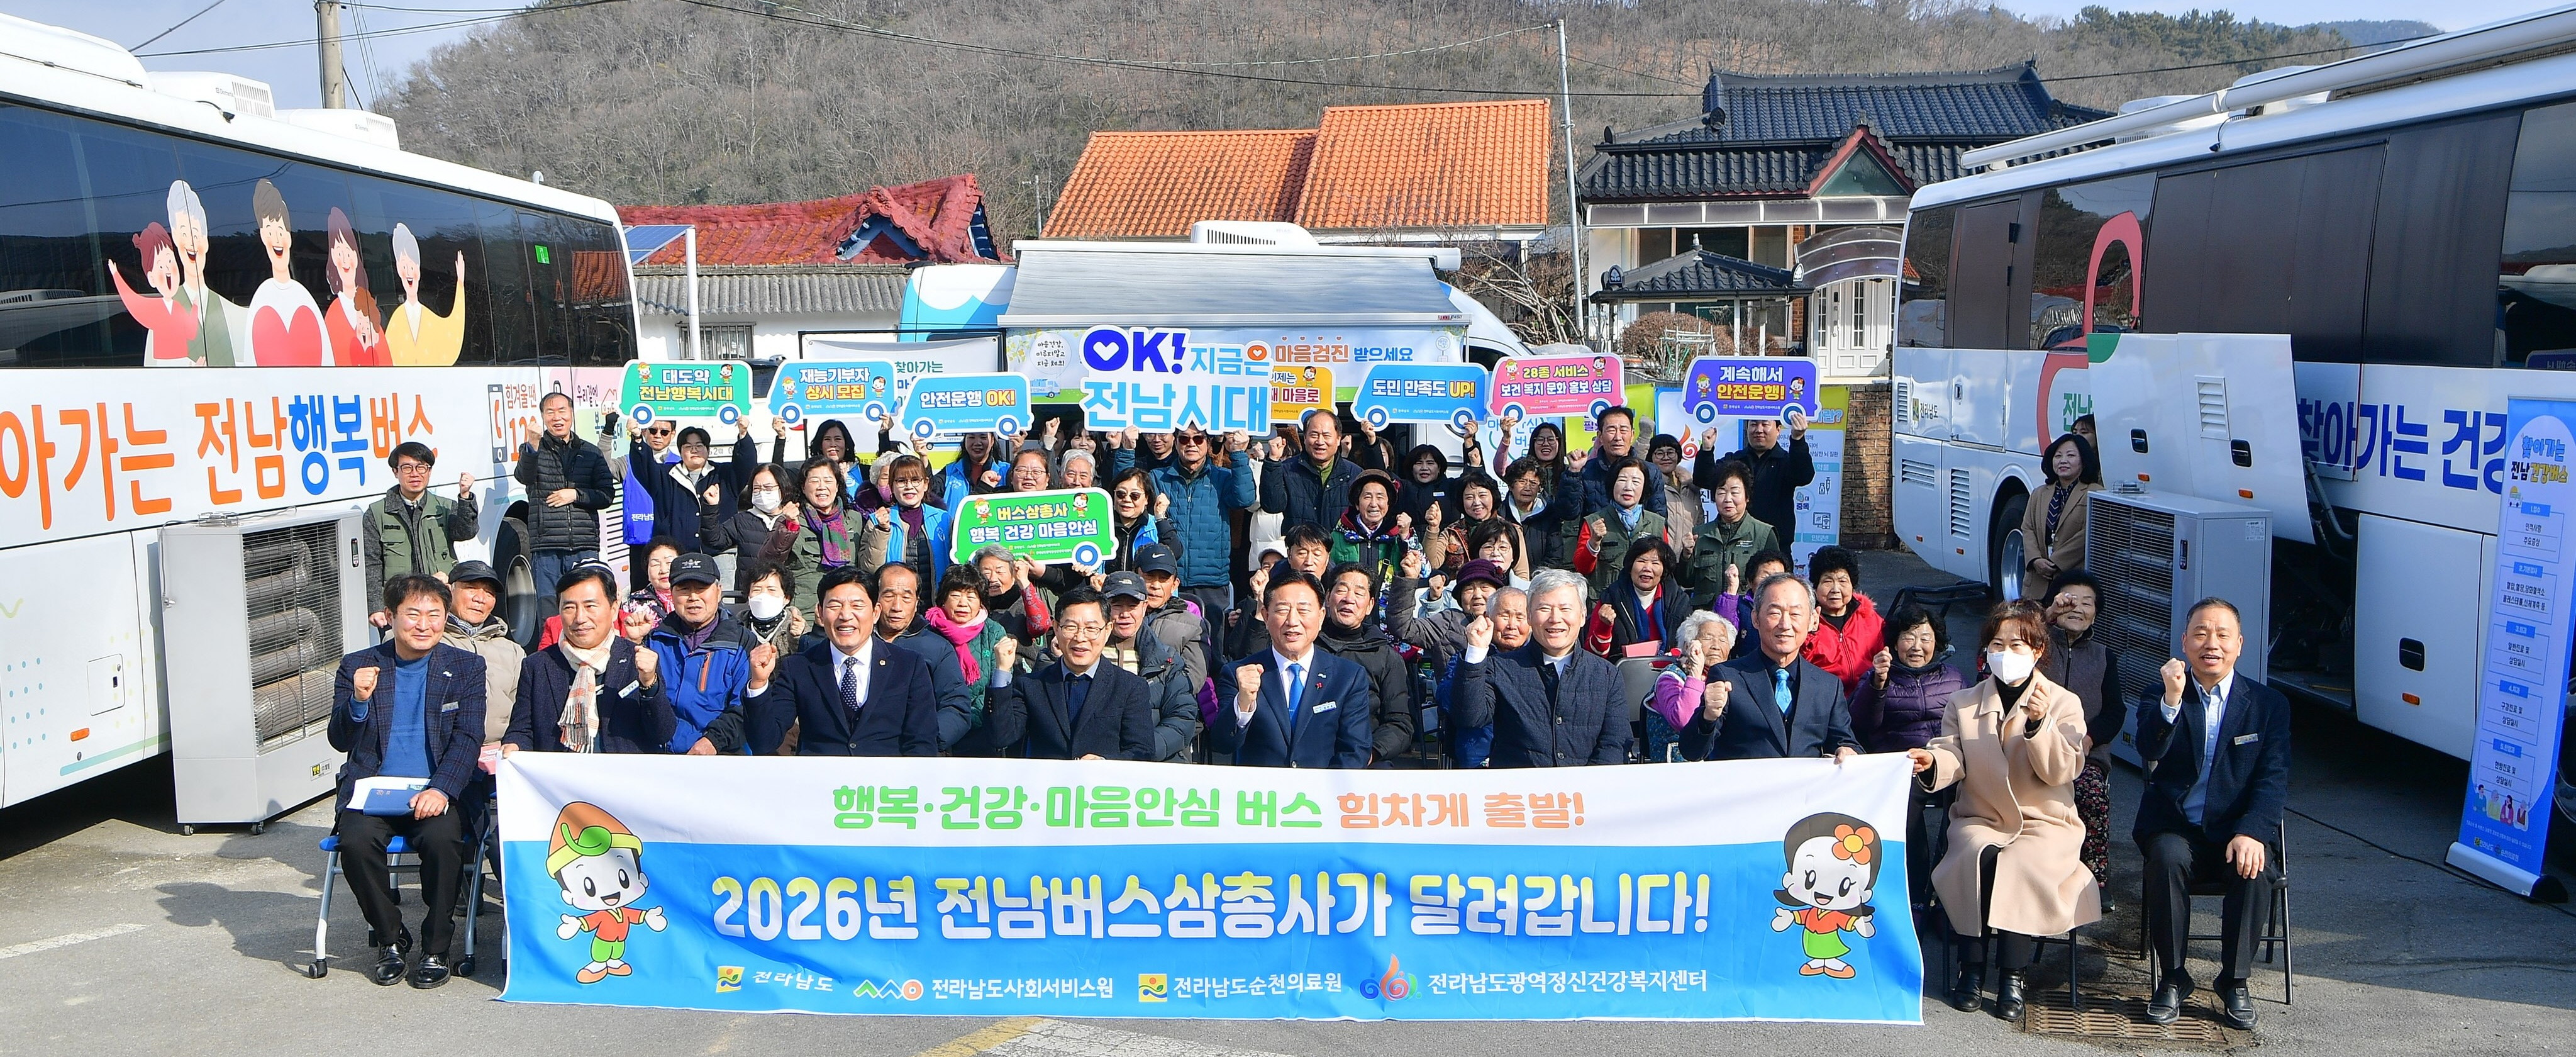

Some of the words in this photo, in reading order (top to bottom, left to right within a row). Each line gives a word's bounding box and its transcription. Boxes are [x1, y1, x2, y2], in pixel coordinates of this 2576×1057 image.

[1084, 330, 1185, 374] OK!
[1191, 345, 1270, 376] 지금은
[1275, 345, 1349, 363] 마음검진
[1353, 347, 1413, 362] 받으세요
[799, 367, 870, 383] 재능기부자
[894, 361, 943, 374] 찾아가는
[1522, 366, 1550, 379] 28종
[1553, 364, 1589, 378] 서비스
[1719, 366, 1784, 383] 계속해서
[662, 369, 710, 384] 대도약
[639, 386, 734, 401] 전남행복시대
[805, 385, 834, 401] 상시
[836, 384, 865, 400] 모집
[1282, 388, 1319, 403] 마을로
[1372, 379, 1401, 396] 도민
[1404, 380, 1447, 398] 만족도
[1450, 381, 1475, 398] UP!
[1501, 383, 1522, 396] 보건
[1524, 382, 1544, 396] 복지
[1546, 381, 1567, 395] 문화
[1568, 380, 1589, 394] 홍보
[1592, 379, 1613, 393] 상담
[1716, 384, 1785, 401] 안전운행!
[919, 390, 982, 409] 안전운행
[985, 389, 1016, 406] OK!
[1084, 382, 1268, 433] 전남시대
[1920, 403, 1938, 420] 전라남도
[195, 392, 438, 505] 전남행복버스
[2522, 436, 2566, 462] 찾아가는
[997, 503, 1069, 522] 버스삼총사
[969, 526, 1001, 544] 행복
[1004, 525, 1035, 541] 건강
[1038, 519, 1099, 539] 마음안심
[2525, 523, 2542, 533] 인적사항
[2524, 537, 2540, 547] 주요증상
[2507, 642, 2524, 653] 일반진료
[2509, 656, 2526, 668] 상담실시
[2501, 702, 2518, 713] 구강진료
[2502, 716, 2519, 727] 상담실시
[1236, 790, 1323, 828] 버스
[1336, 792, 1470, 828] 힘차게
[1484, 791, 1585, 829] 출발!
[712, 875, 919, 941] 2026년
[935, 871, 1392, 939] 전남버스삼총사가
[1409, 871, 1710, 937] 달려갑니다!
[755, 970, 834, 992] 전라남도
[931, 978, 1113, 1000] 전라남도사회서비스원
[1173, 972, 1342, 998] 전라남도순천의료원
[1427, 970, 1707, 995] 전라남도광역정신건강복지센터
